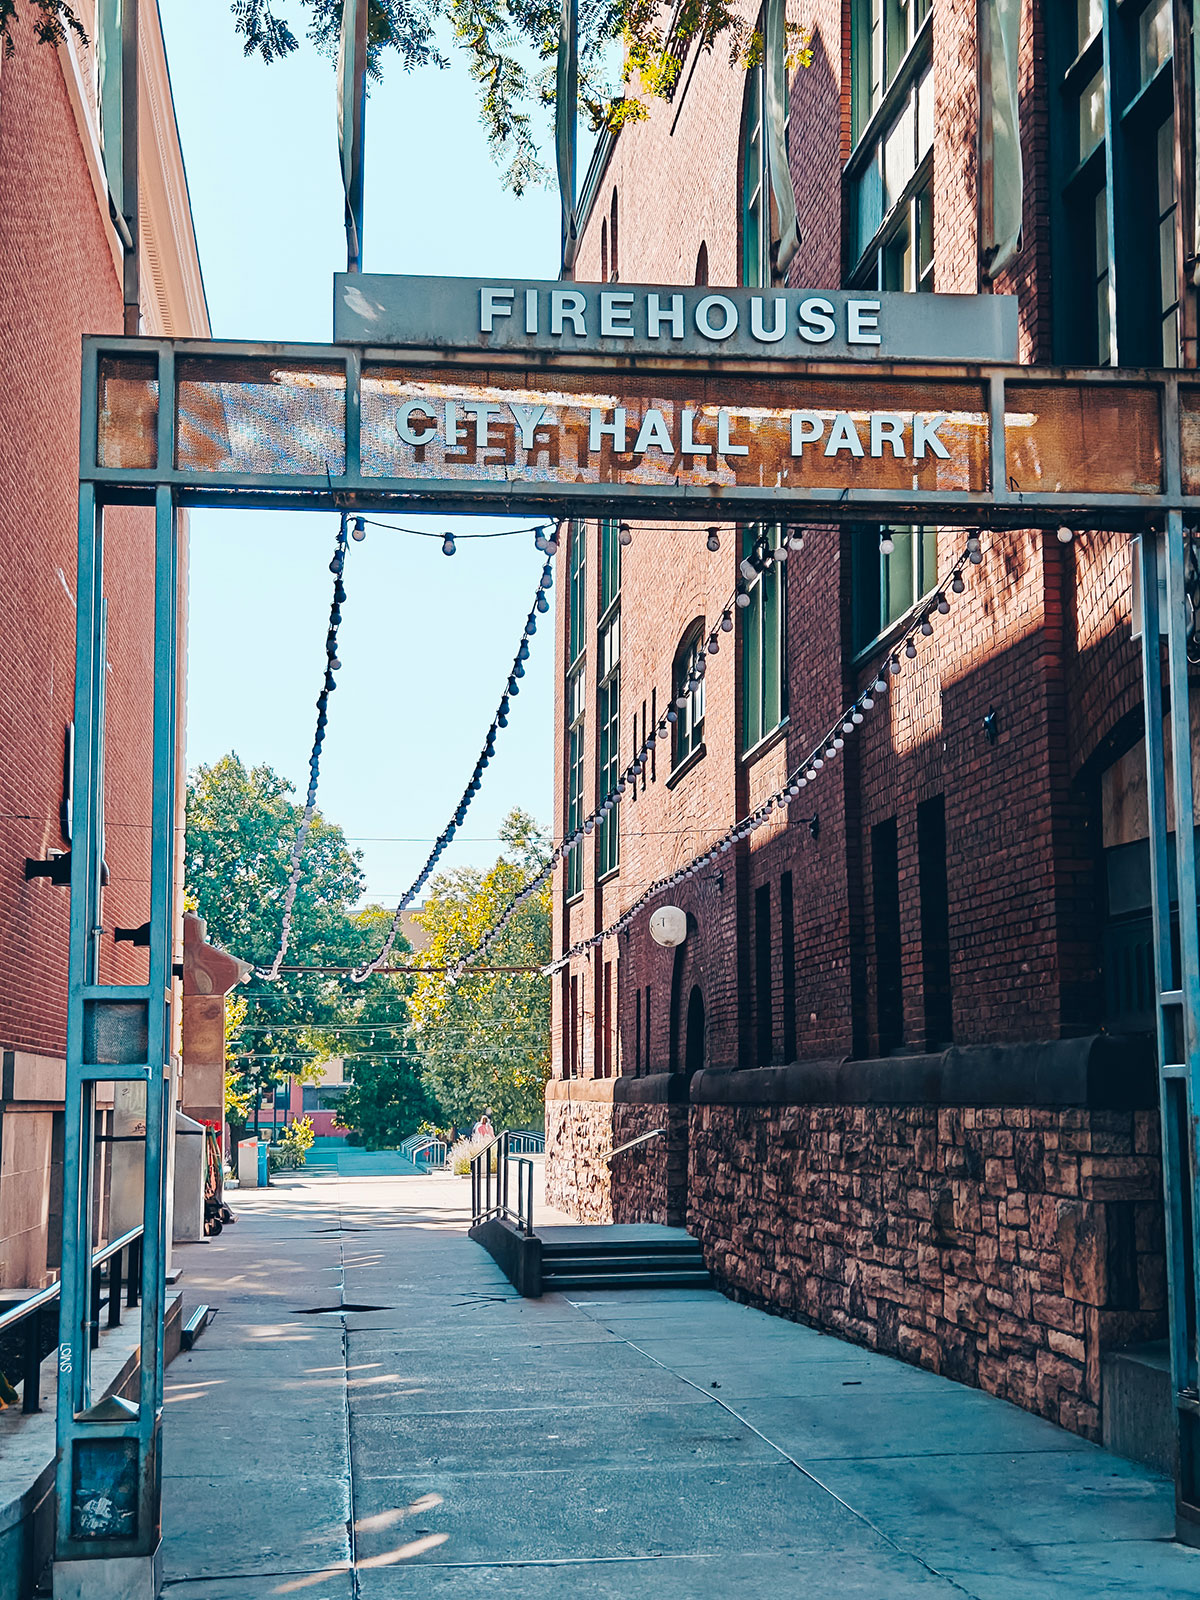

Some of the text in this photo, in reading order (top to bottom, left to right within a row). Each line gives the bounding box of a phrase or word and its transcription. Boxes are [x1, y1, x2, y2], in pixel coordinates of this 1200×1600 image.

[480, 287, 882, 345] FIREHOUSE
[396, 400, 547, 449] CITY
[589, 408, 749, 456] HALL
[791, 413, 951, 459] PARK
